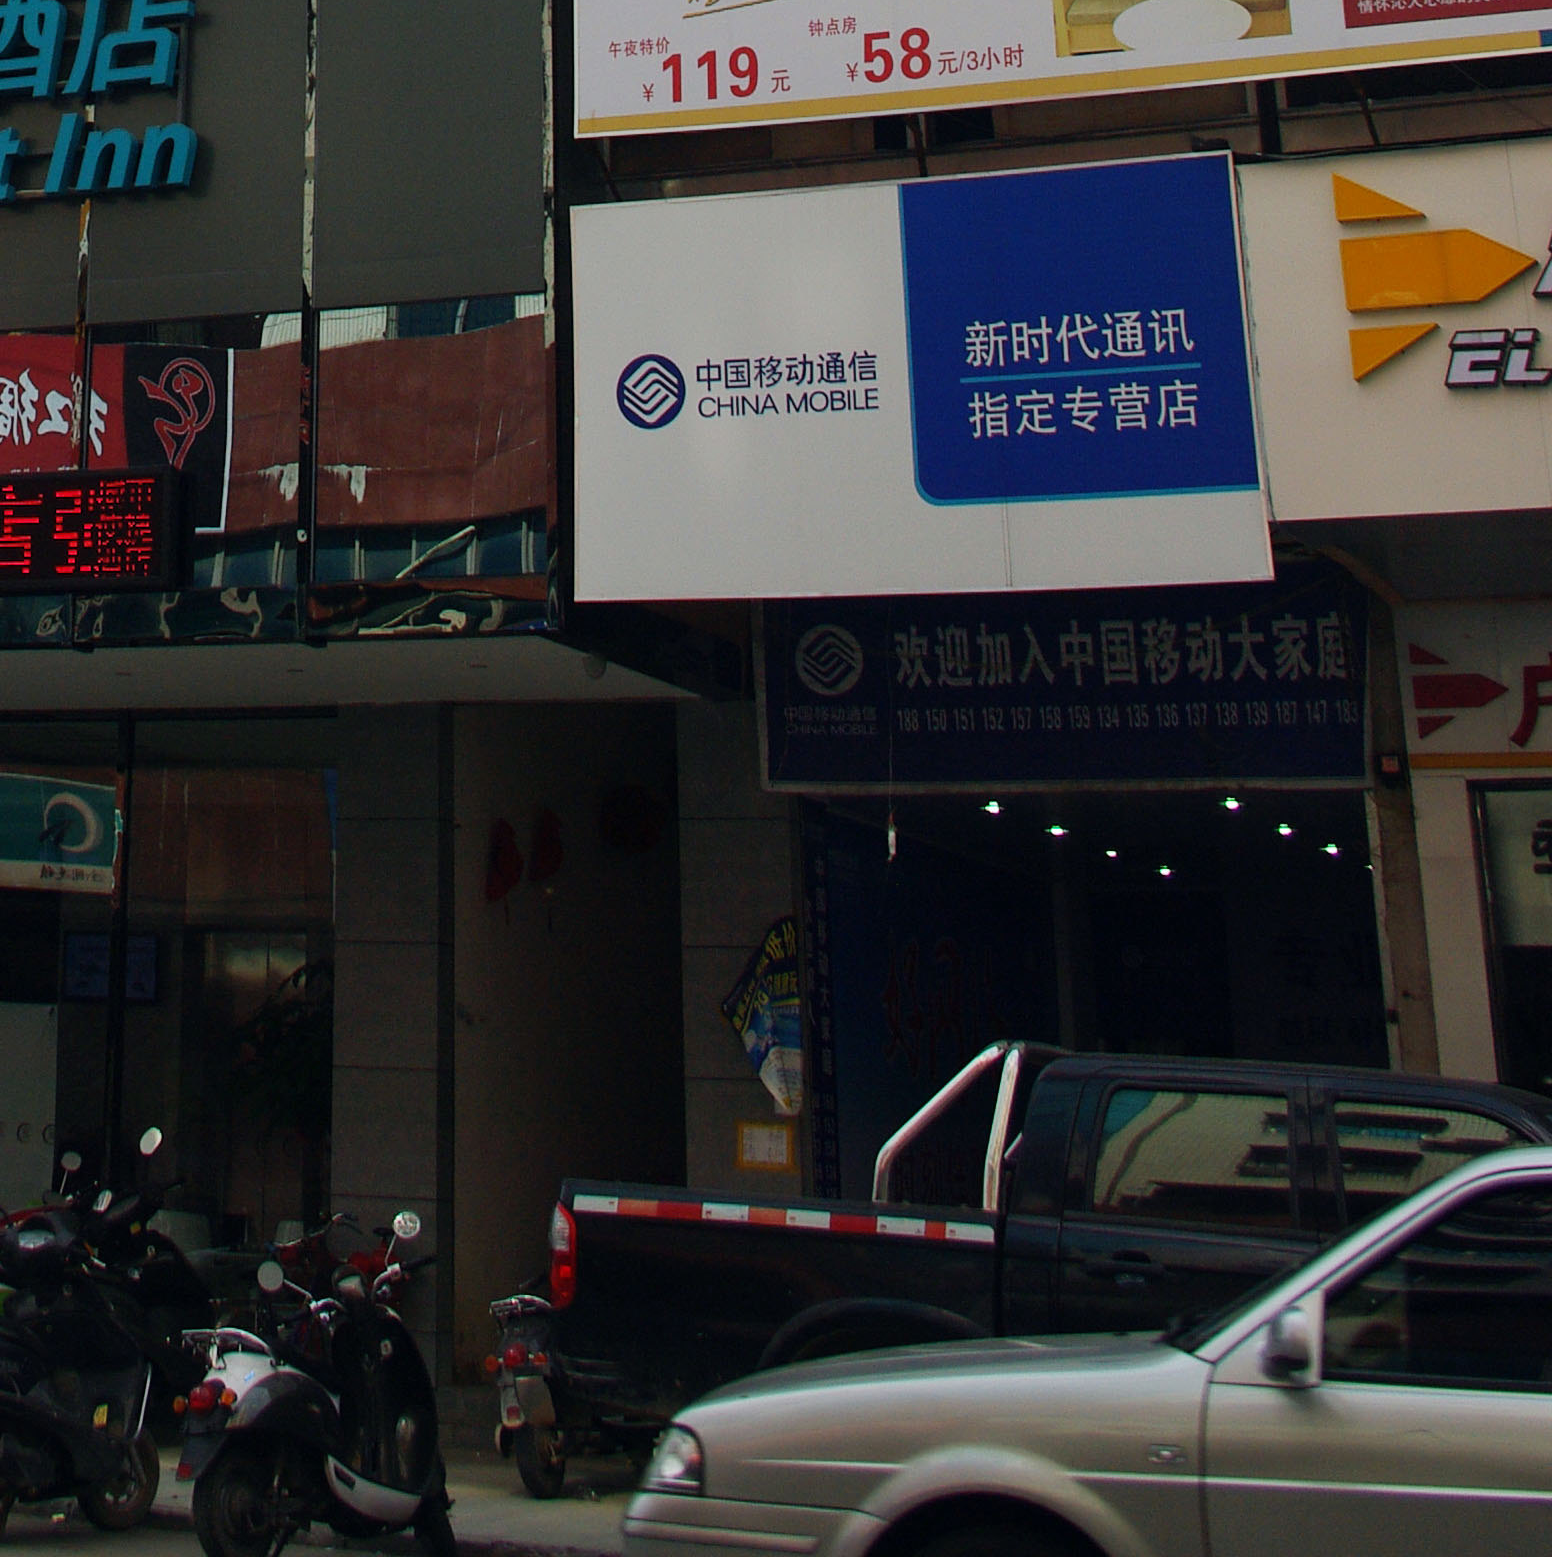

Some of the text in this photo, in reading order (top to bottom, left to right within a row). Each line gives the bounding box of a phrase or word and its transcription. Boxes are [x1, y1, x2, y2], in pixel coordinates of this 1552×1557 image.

[608, 36, 670, 58] 午夜特价
[808, 16, 857, 37] 钟点房
[45, 112, 198, 193] Inn
[963, 308, 1195, 368] 新时代通讯
[695, 350, 878, 389] 中国移动通信
[697, 386, 880, 419] CHINA MOBILE
[969, 379, 1199, 439] 指定专营店
[895, 611, 1350, 688] 欢迎加入中国移动大家庭
